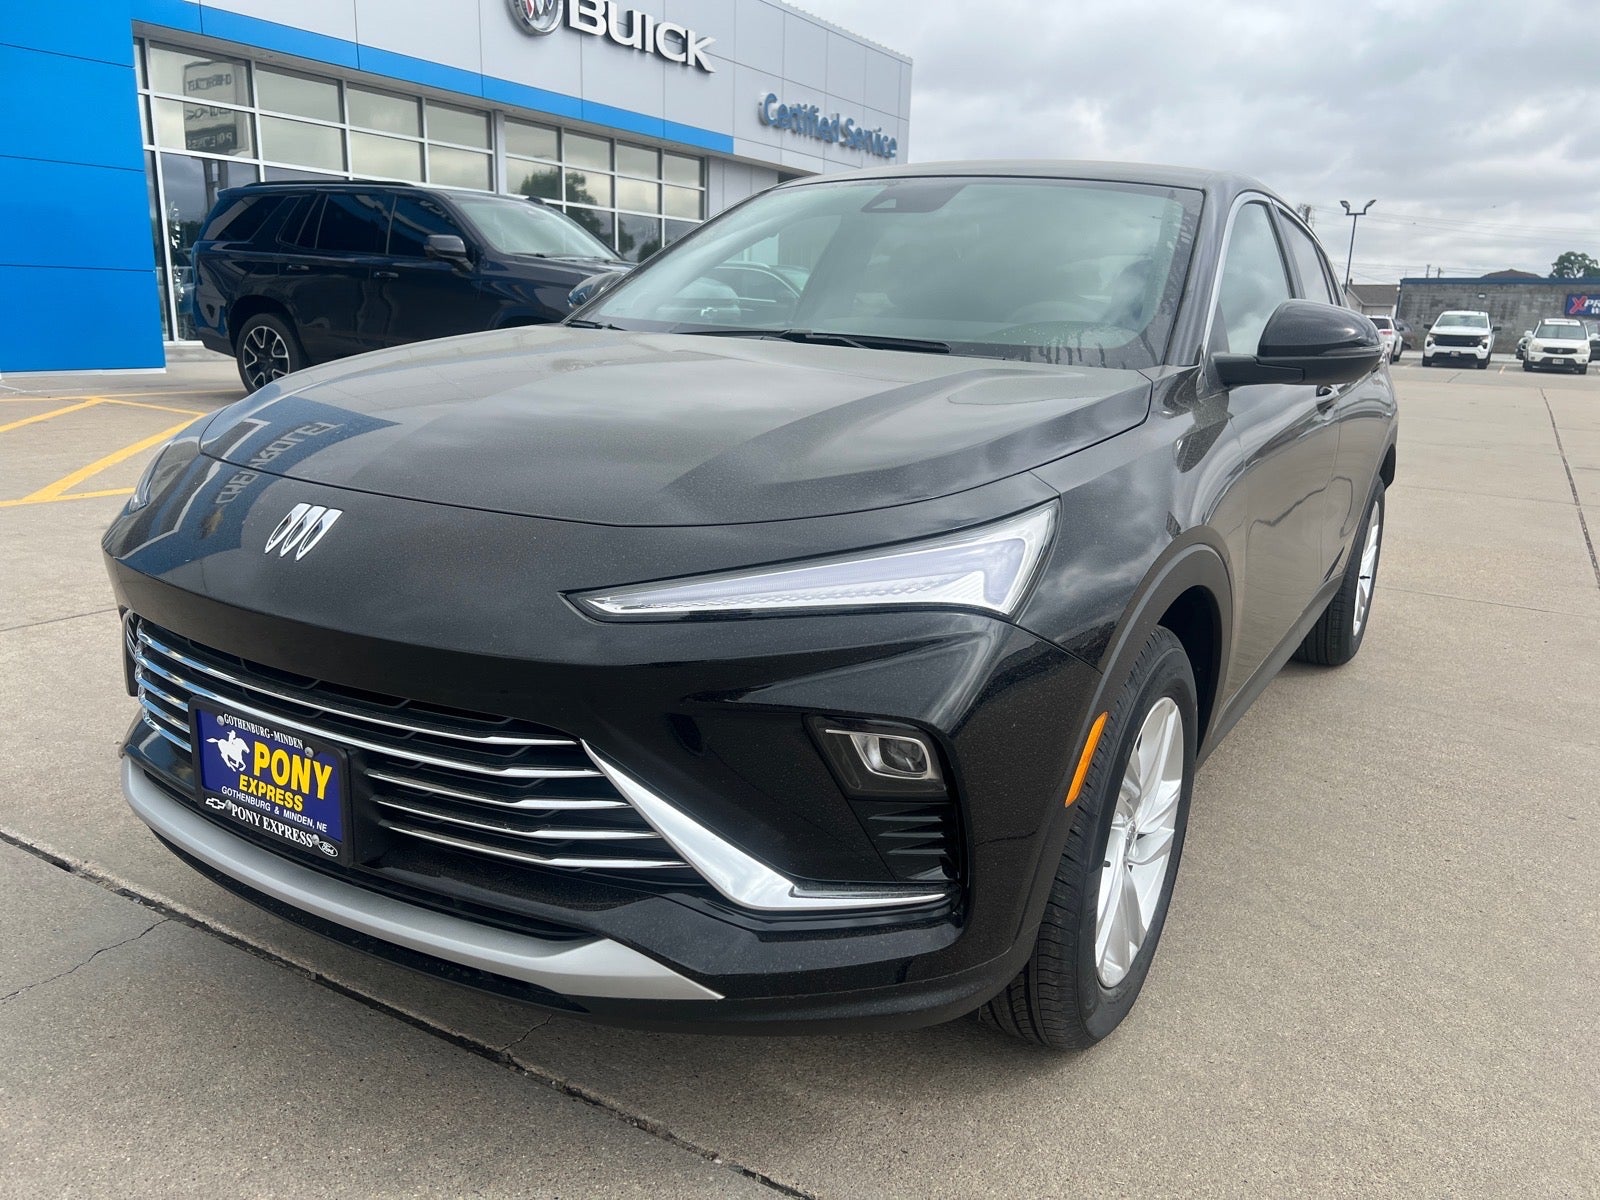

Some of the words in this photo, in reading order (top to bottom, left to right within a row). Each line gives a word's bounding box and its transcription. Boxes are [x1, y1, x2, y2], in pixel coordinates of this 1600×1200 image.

[567, 0, 716, 73] BUICK
[758, 92, 840, 144] Certified
[841, 117, 897, 159] Service
[238, 774, 304, 812] EXPRESS
[253, 740, 333, 800] PONY
[221, 785, 271, 812] GOTHENBURG
[273, 806, 280, 815] &
[283, 809, 315, 829] MINDEN,
[316, 822, 328, 833] NE
[231, 803, 261, 828] PONY
[262, 815, 313, 848] EXPRESS
